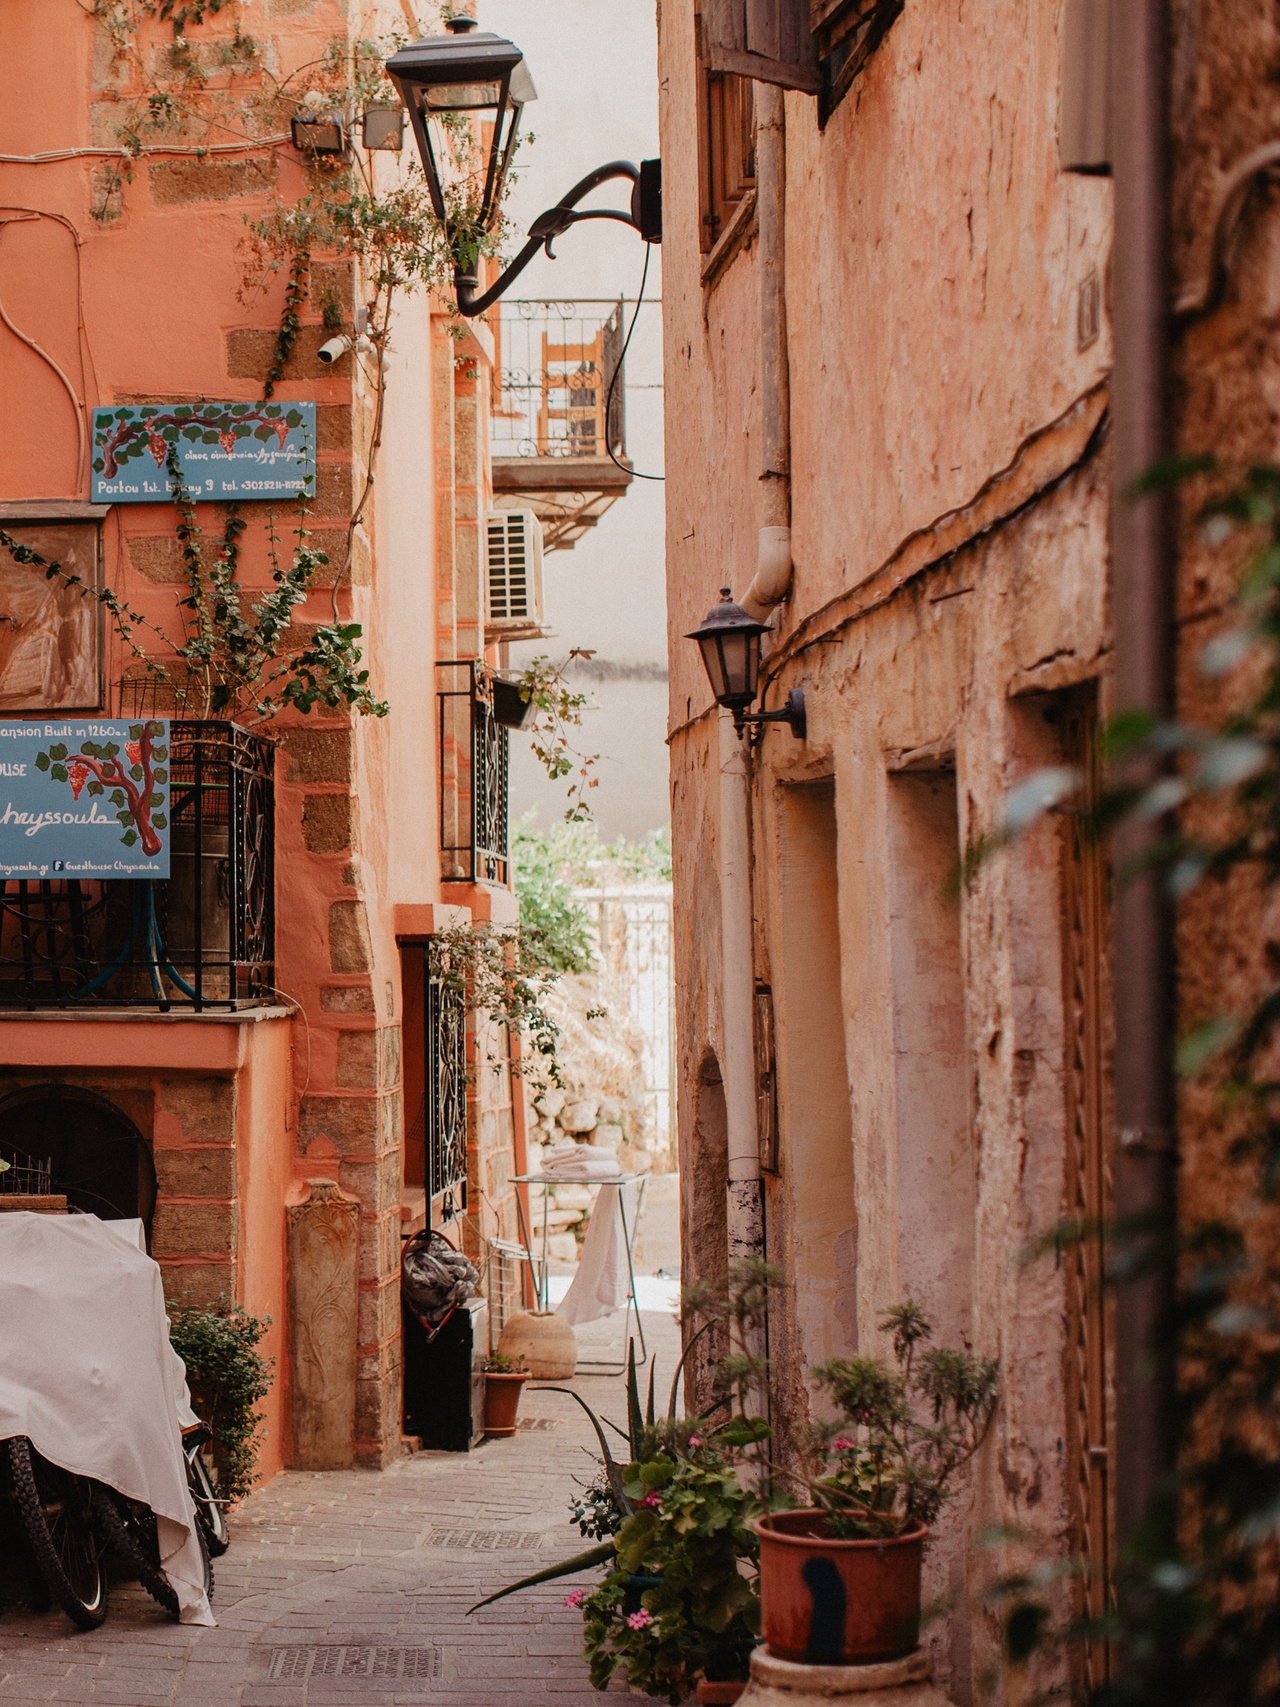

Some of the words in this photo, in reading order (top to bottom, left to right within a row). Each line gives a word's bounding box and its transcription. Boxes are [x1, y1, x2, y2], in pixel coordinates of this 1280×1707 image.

[98, 480, 139, 494] Portou
[205, 479, 214, 491] 9
[222, 480, 239, 491] tel.
[44, 725, 73, 737] Built
[76, 729, 87, 738] in
[65, 860, 112, 870] Guesthouse
